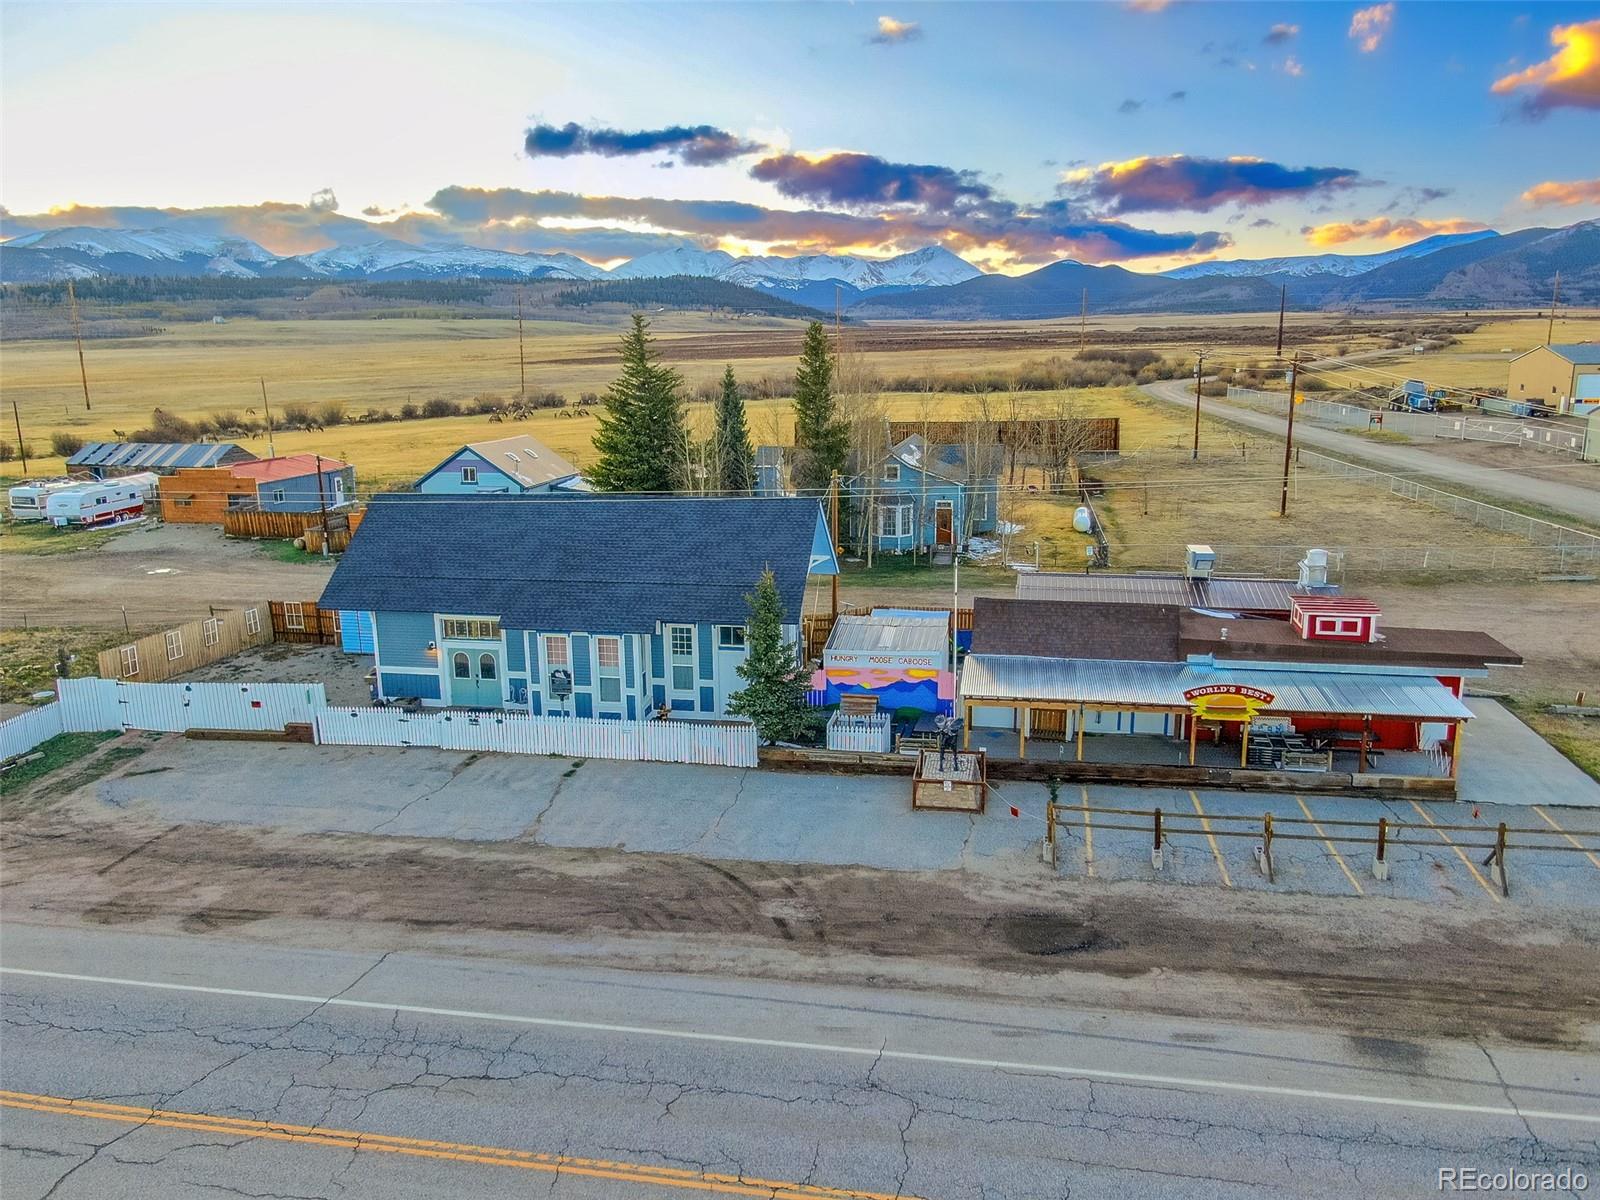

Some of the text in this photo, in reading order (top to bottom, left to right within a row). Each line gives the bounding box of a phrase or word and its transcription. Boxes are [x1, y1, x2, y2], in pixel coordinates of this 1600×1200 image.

[830, 655, 932, 666] HUNGRY MOOSE CABOOSE
[1191, 686, 1267, 700] WORLD'S BEST
